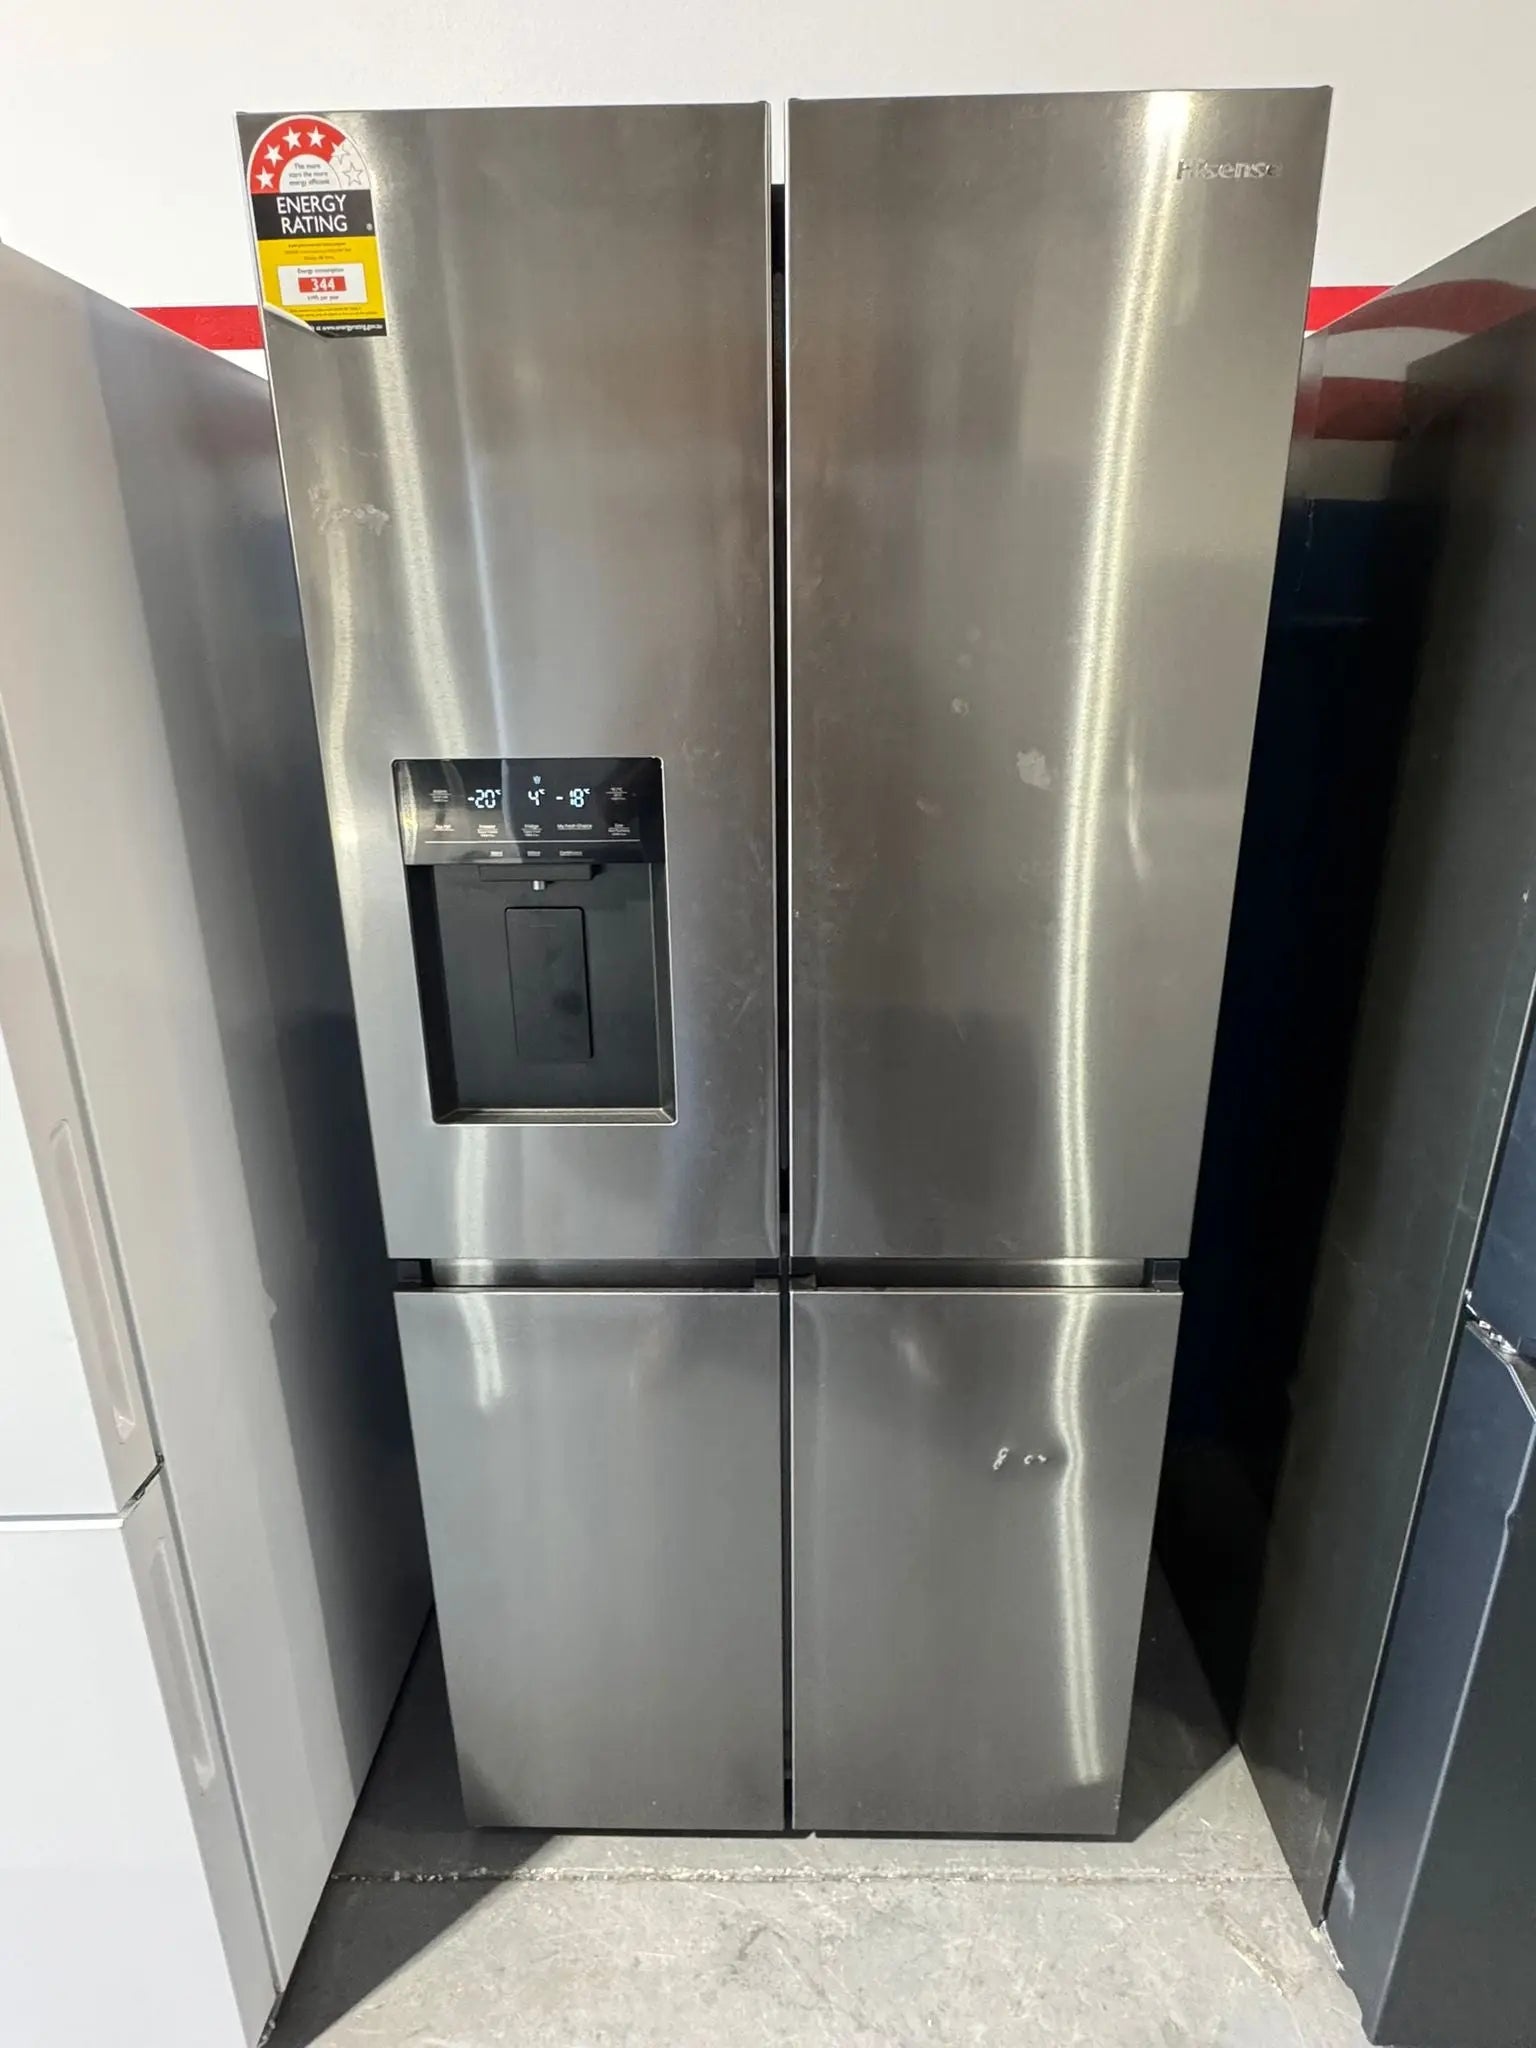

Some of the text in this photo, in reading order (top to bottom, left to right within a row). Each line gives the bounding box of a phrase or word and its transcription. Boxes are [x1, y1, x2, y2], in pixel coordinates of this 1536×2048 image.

[276, 194, 347, 214] ENERGY
[281, 214, 348, 234] RATING
[310, 277, 336, 292] 344
